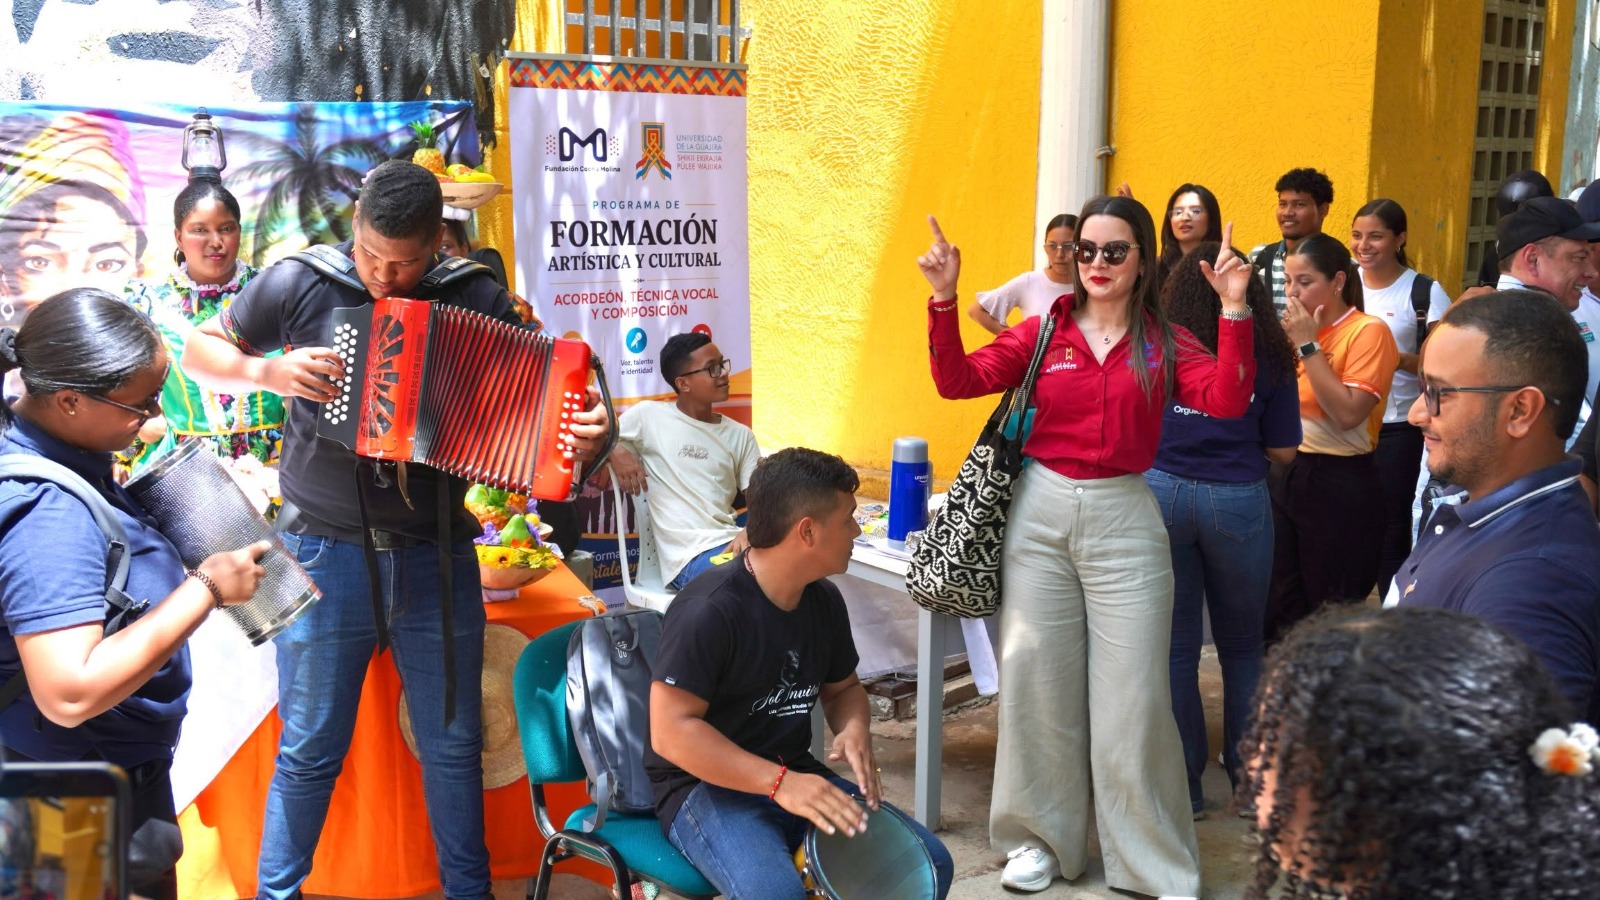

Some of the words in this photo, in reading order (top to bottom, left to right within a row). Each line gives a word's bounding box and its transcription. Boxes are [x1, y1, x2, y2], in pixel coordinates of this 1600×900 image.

[676, 134, 722, 142] UNIVERSIDAD
[592, 200, 660, 210] PROGRAMA
[665, 200, 681, 209] DE
[550, 213, 718, 248] FORMACIÓN
[547, 251, 631, 272] ARTÍSTICA
[635, 254, 645, 269] Y
[649, 252, 722, 269] CULTURAL
[554, 289, 627, 306] ACORDEÓN,
[630, 287, 680, 302] TÉCNICA
[681, 287, 719, 300] VOCAL
[591, 308, 598, 320] Y
[602, 304, 688, 319] COMPOSICIÓN
[626, 367, 653, 375] identidad
